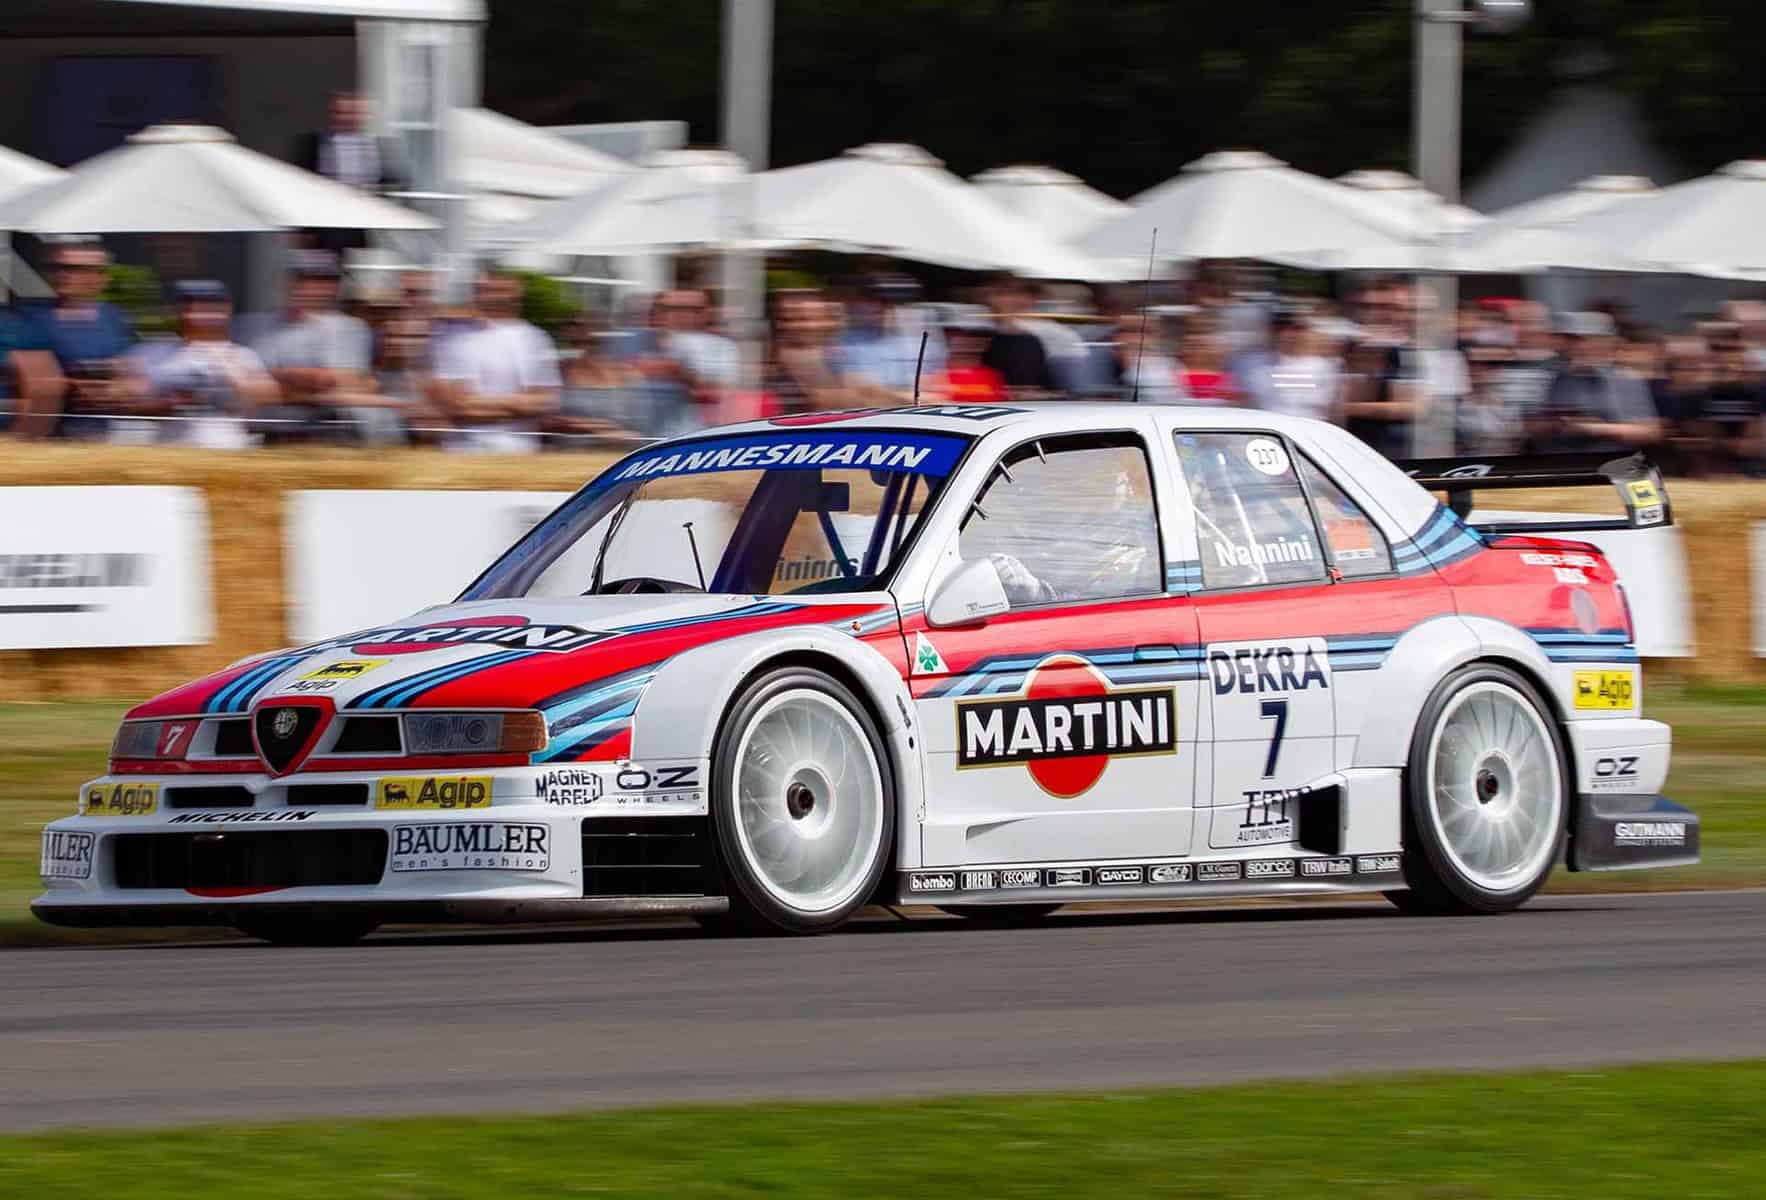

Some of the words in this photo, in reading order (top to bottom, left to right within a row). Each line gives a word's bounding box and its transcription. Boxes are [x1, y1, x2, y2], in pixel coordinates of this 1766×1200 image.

[613, 443, 932, 481] MANNESMANN
[1213, 535, 1315, 568] Nannini
[1210, 644, 1329, 696] DEKRA
[163, 725, 187, 755] 7
[965, 696, 1170, 759] MARTINI
[1259, 697, 1290, 780] 7
[109, 783, 154, 815] Agip
[417, 776, 485, 809] Agip
[168, 810, 318, 824] MICHELIN
[394, 824, 548, 855] BÄUMLER
[393, 857, 449, 869] men's
[463, 855, 547, 868] fashion
